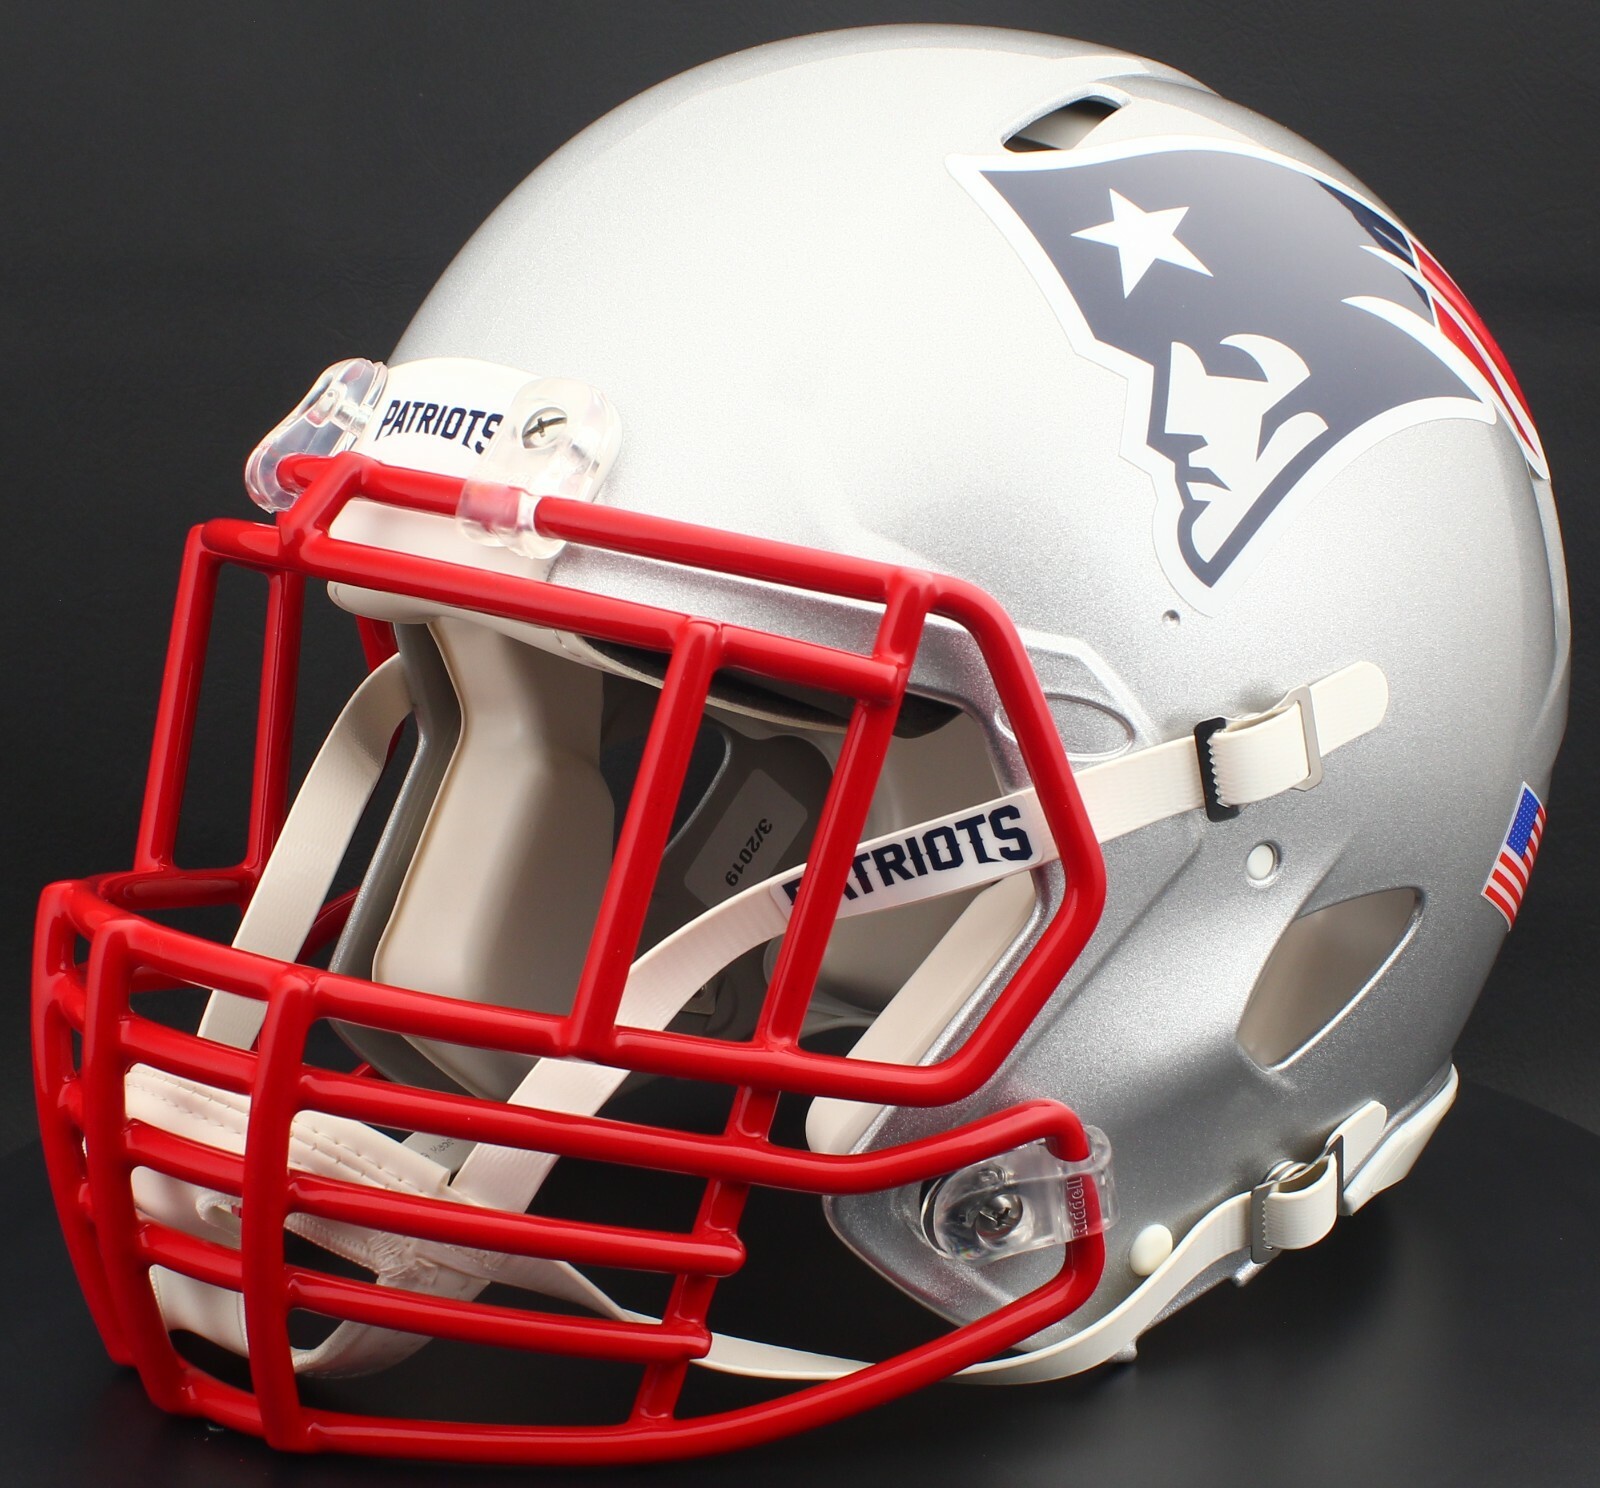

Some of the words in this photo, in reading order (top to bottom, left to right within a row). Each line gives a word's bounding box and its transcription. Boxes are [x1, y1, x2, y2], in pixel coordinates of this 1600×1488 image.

[375, 399, 504, 455] PATRIOTS
[725, 818, 773, 887] 3/2019
[782, 805, 1033, 906] TRIOTS
